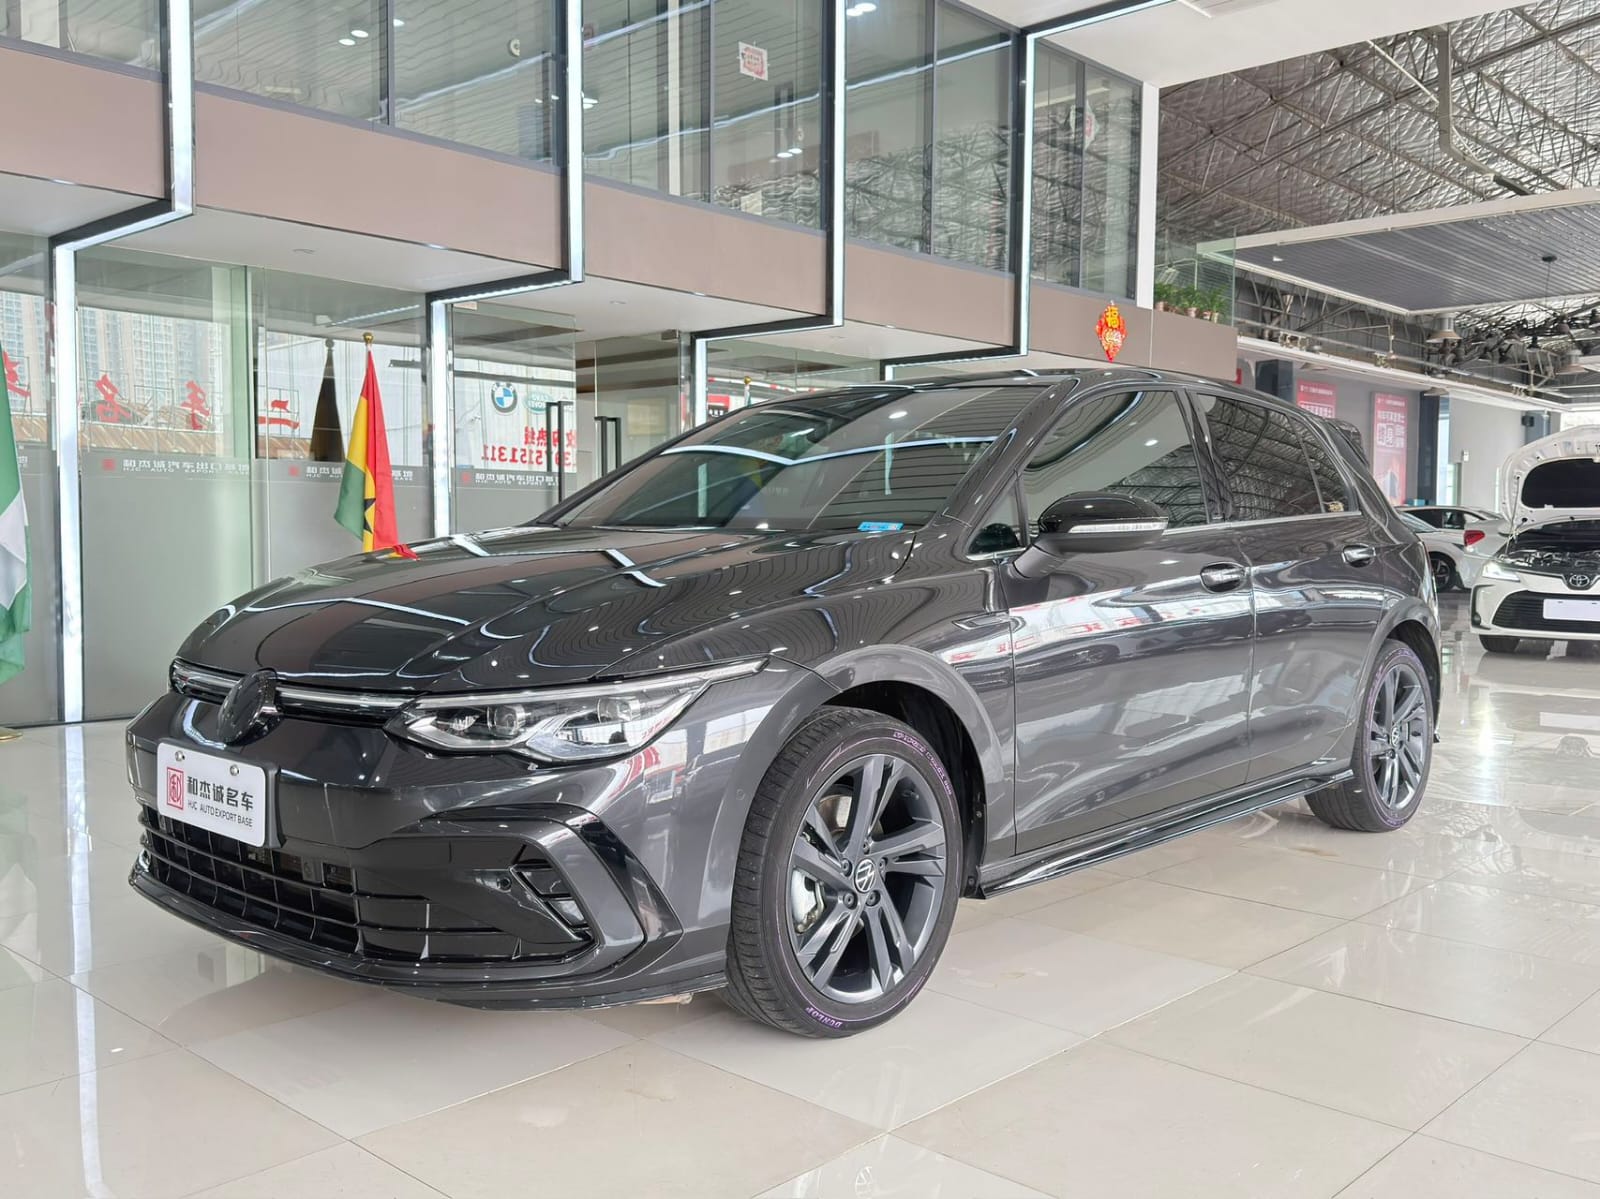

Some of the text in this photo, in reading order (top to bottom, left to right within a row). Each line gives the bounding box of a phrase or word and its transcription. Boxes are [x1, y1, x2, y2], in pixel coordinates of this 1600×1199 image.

[1105, 305, 1119, 328] 福
[187, 775, 254, 811] 和杰诚名车
[187, 799, 253, 828] HJC AUTO EXPORT BASE
[804, 1006, 844, 1029] DUNLOP
